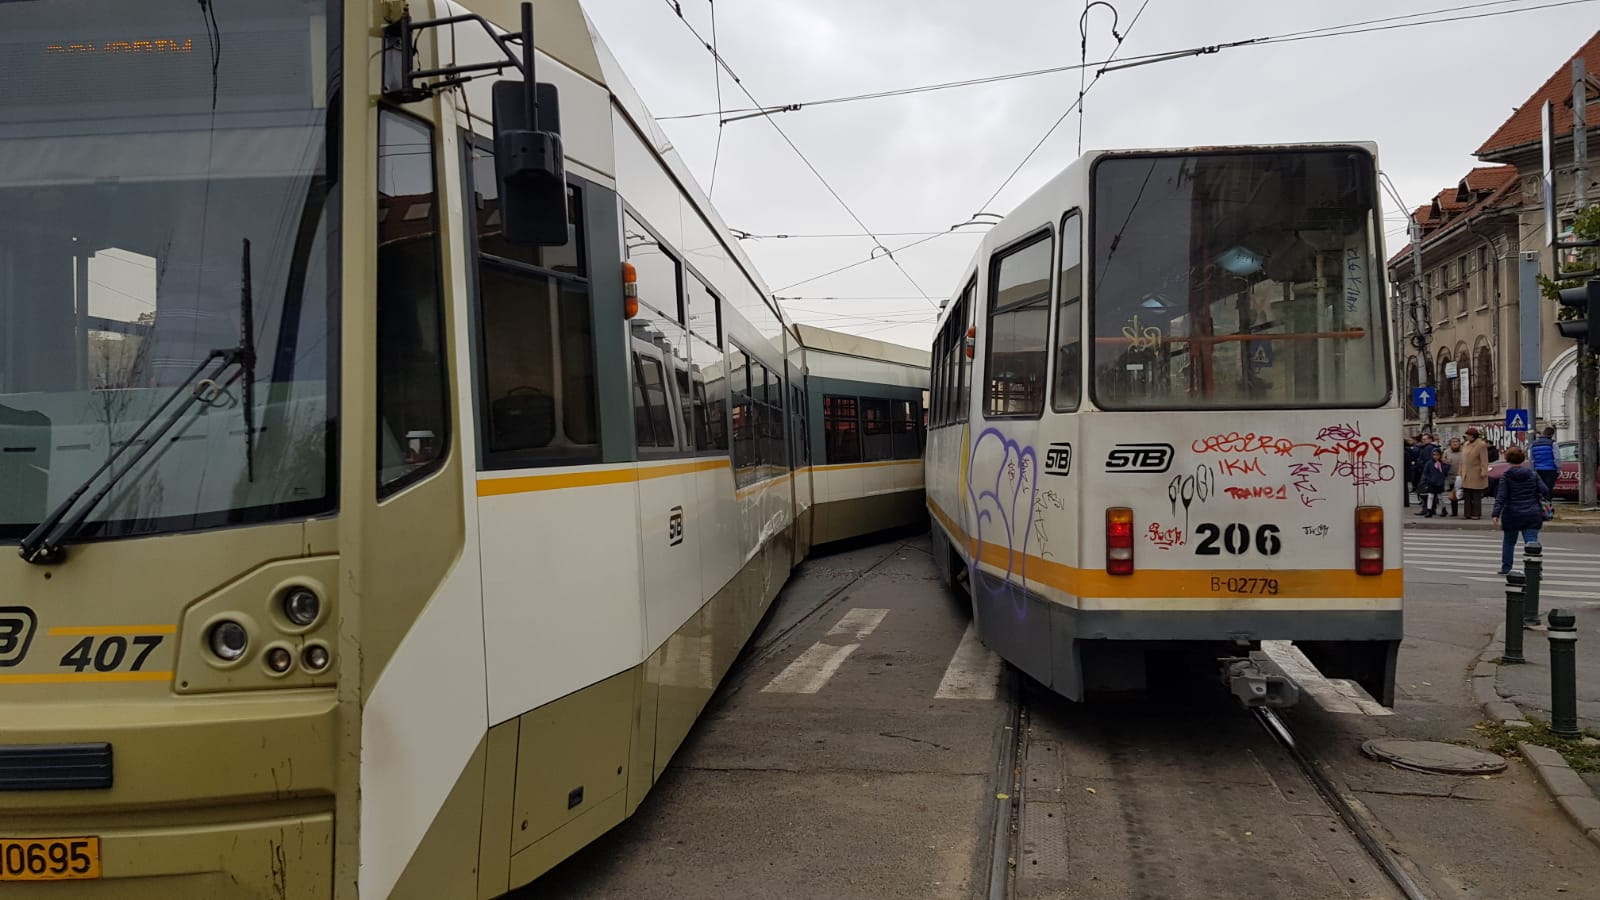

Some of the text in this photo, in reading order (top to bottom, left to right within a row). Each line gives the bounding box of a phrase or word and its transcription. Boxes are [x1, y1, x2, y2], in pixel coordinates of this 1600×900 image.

[1045, 448, 1070, 470] STB
[1105, 448, 1169, 469] STB
[670, 513, 682, 539] STB
[1194, 522, 1282, 556] 206
[1210, 576, 1279, 595] B-02779
[59, 635, 165, 673] 407
